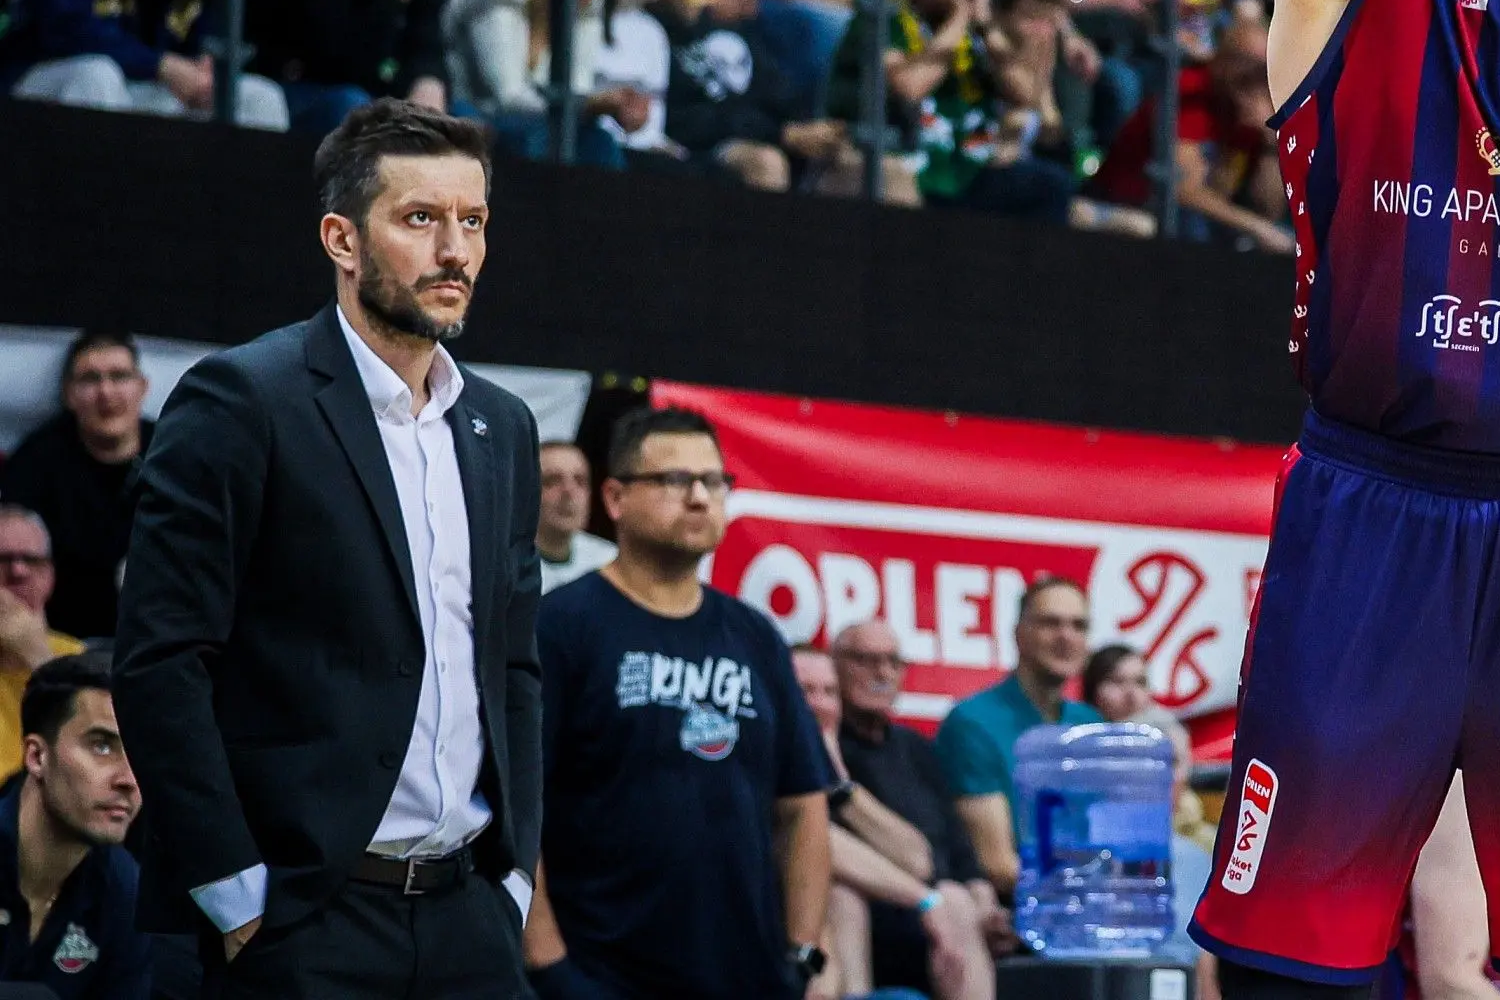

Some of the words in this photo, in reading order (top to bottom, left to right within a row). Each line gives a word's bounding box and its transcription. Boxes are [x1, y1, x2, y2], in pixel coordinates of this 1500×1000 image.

[1374, 180, 1433, 217] KING
[1451, 342, 1480, 352] szczecin
[1247, 777, 1270, 798] ORLEN
